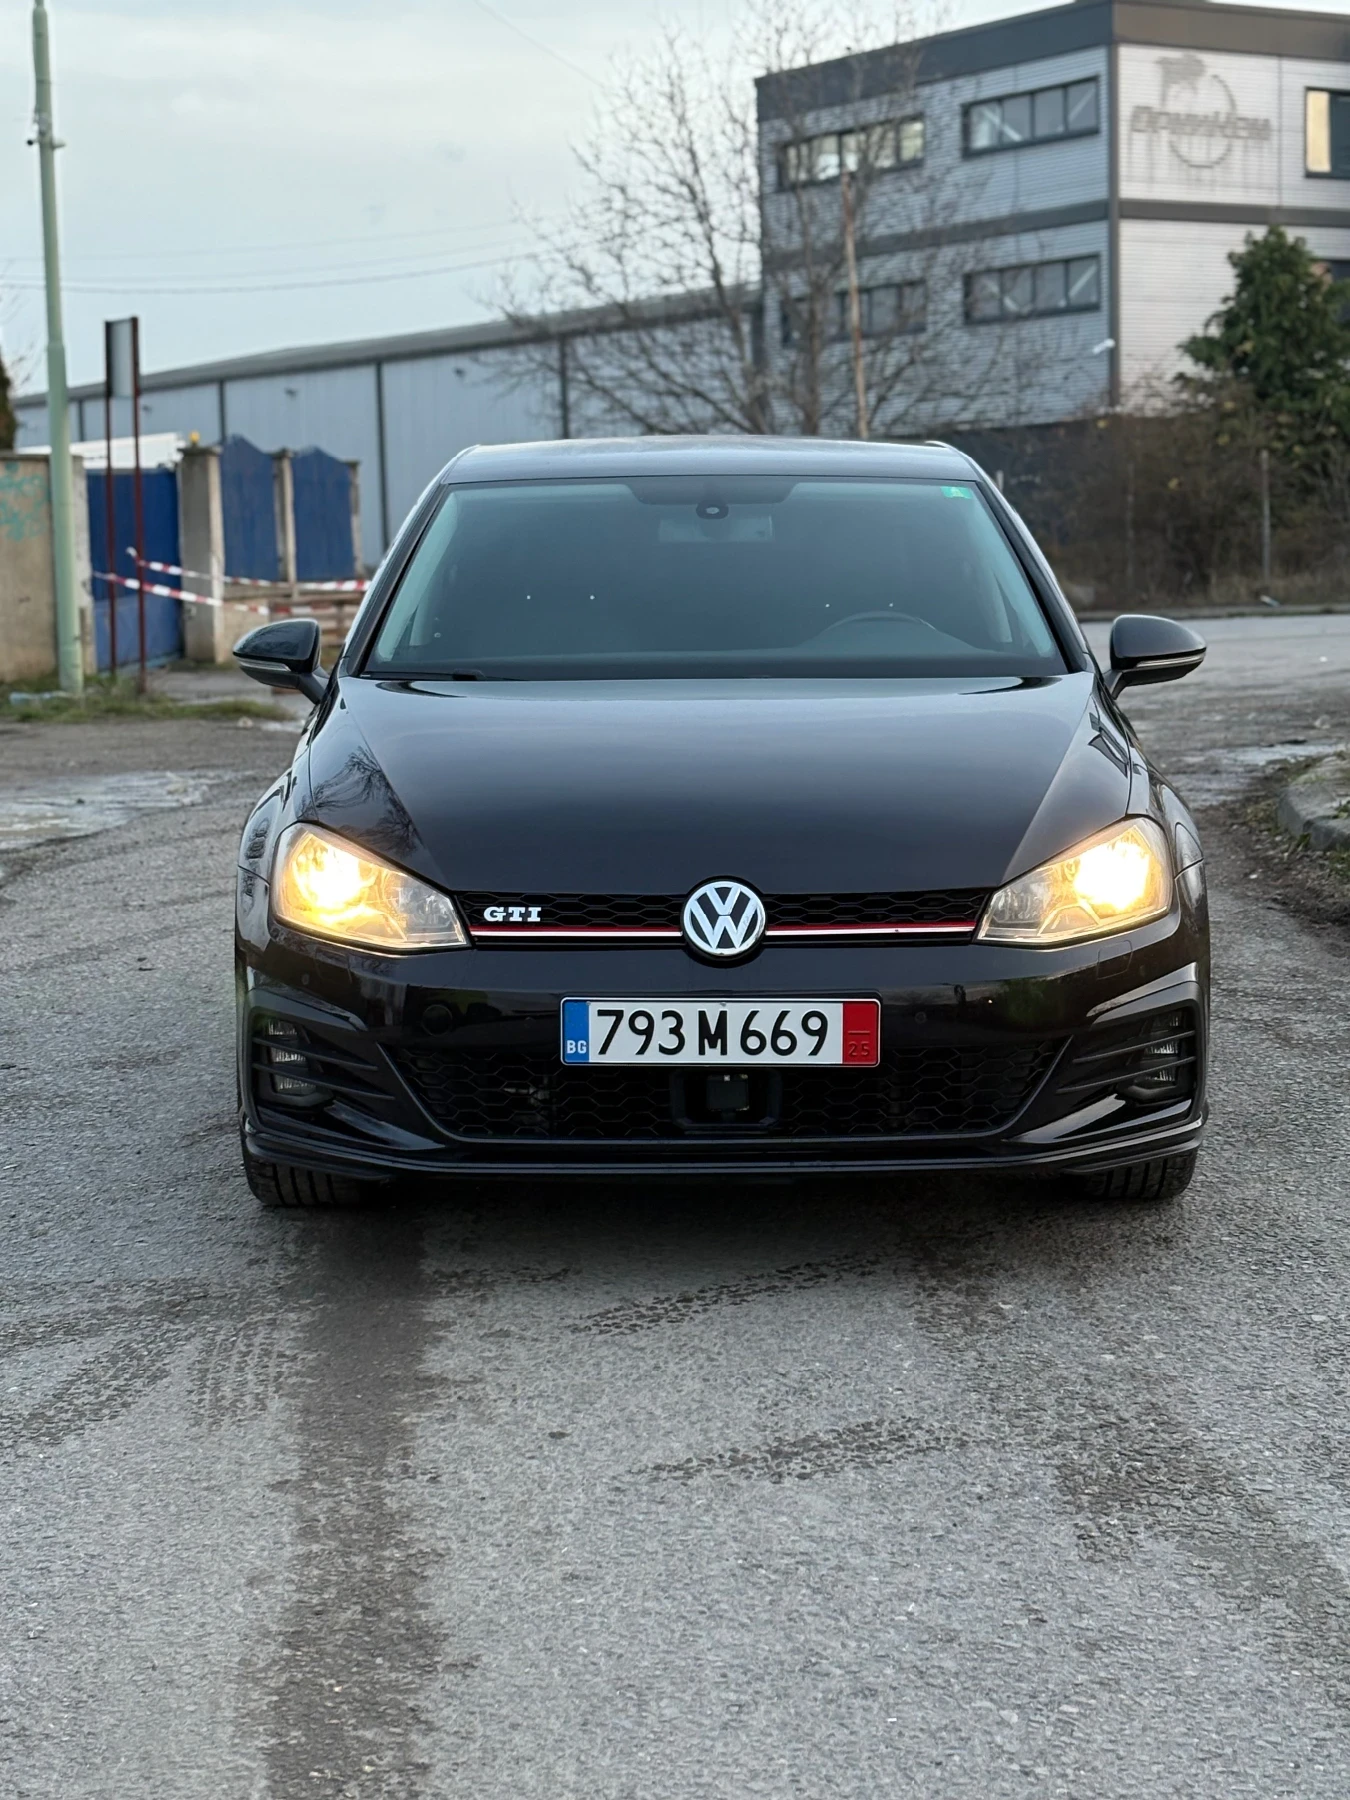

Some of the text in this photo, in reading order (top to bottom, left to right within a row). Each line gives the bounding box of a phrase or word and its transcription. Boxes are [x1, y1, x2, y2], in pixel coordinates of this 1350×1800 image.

[483, 906, 542, 922] GTI
[686, 882, 764, 954] VW
[597, 1009, 829, 1056] 793 M 669
[566, 1039, 587, 1054] BG
[848, 1041, 870, 1057] 25
